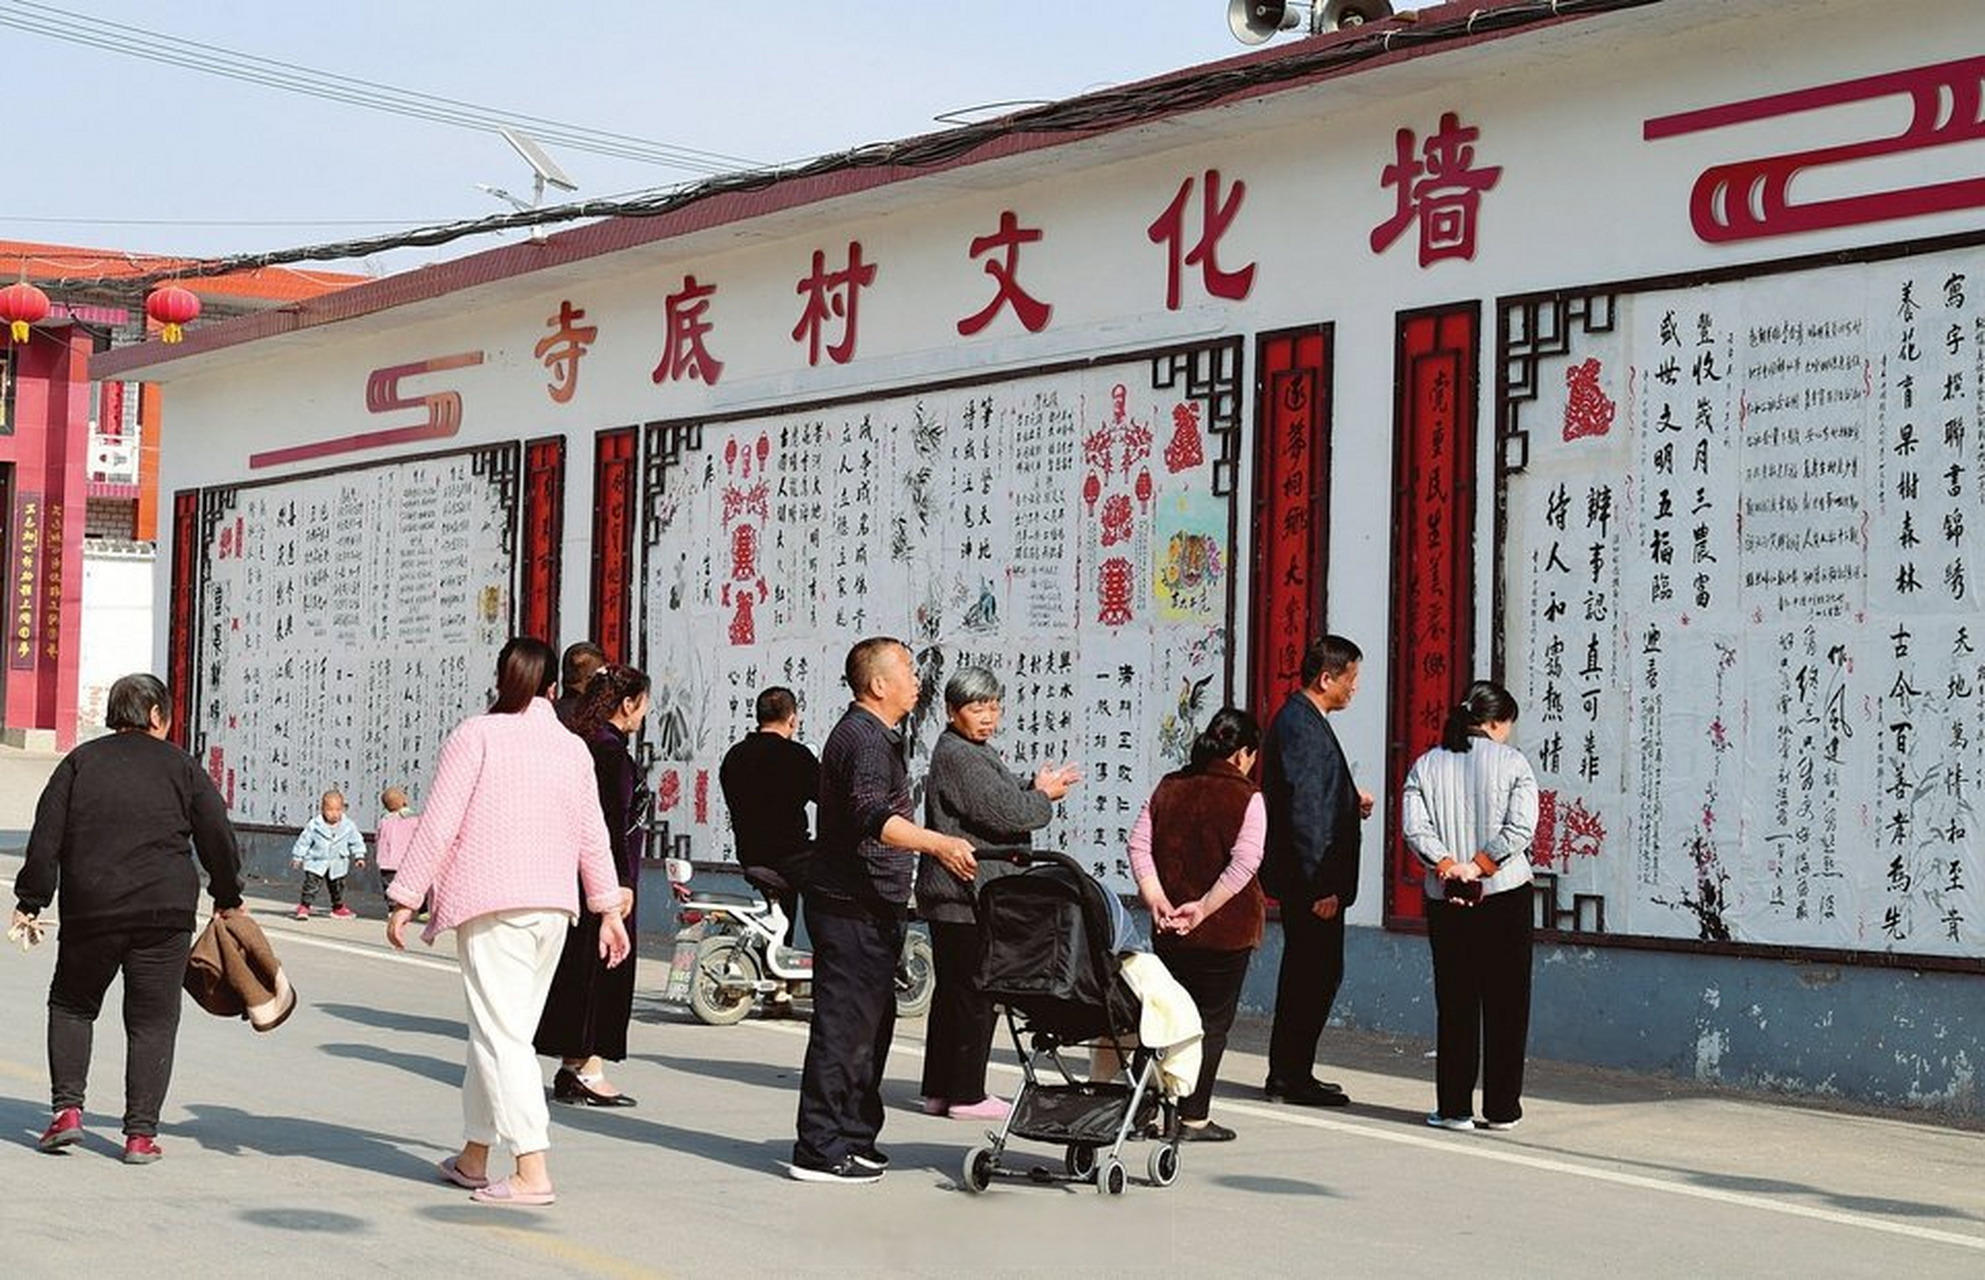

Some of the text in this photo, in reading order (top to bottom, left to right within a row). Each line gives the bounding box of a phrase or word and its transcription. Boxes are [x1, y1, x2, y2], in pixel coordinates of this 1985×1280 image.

[532, 111, 1502, 404] 寺底村文化墙
